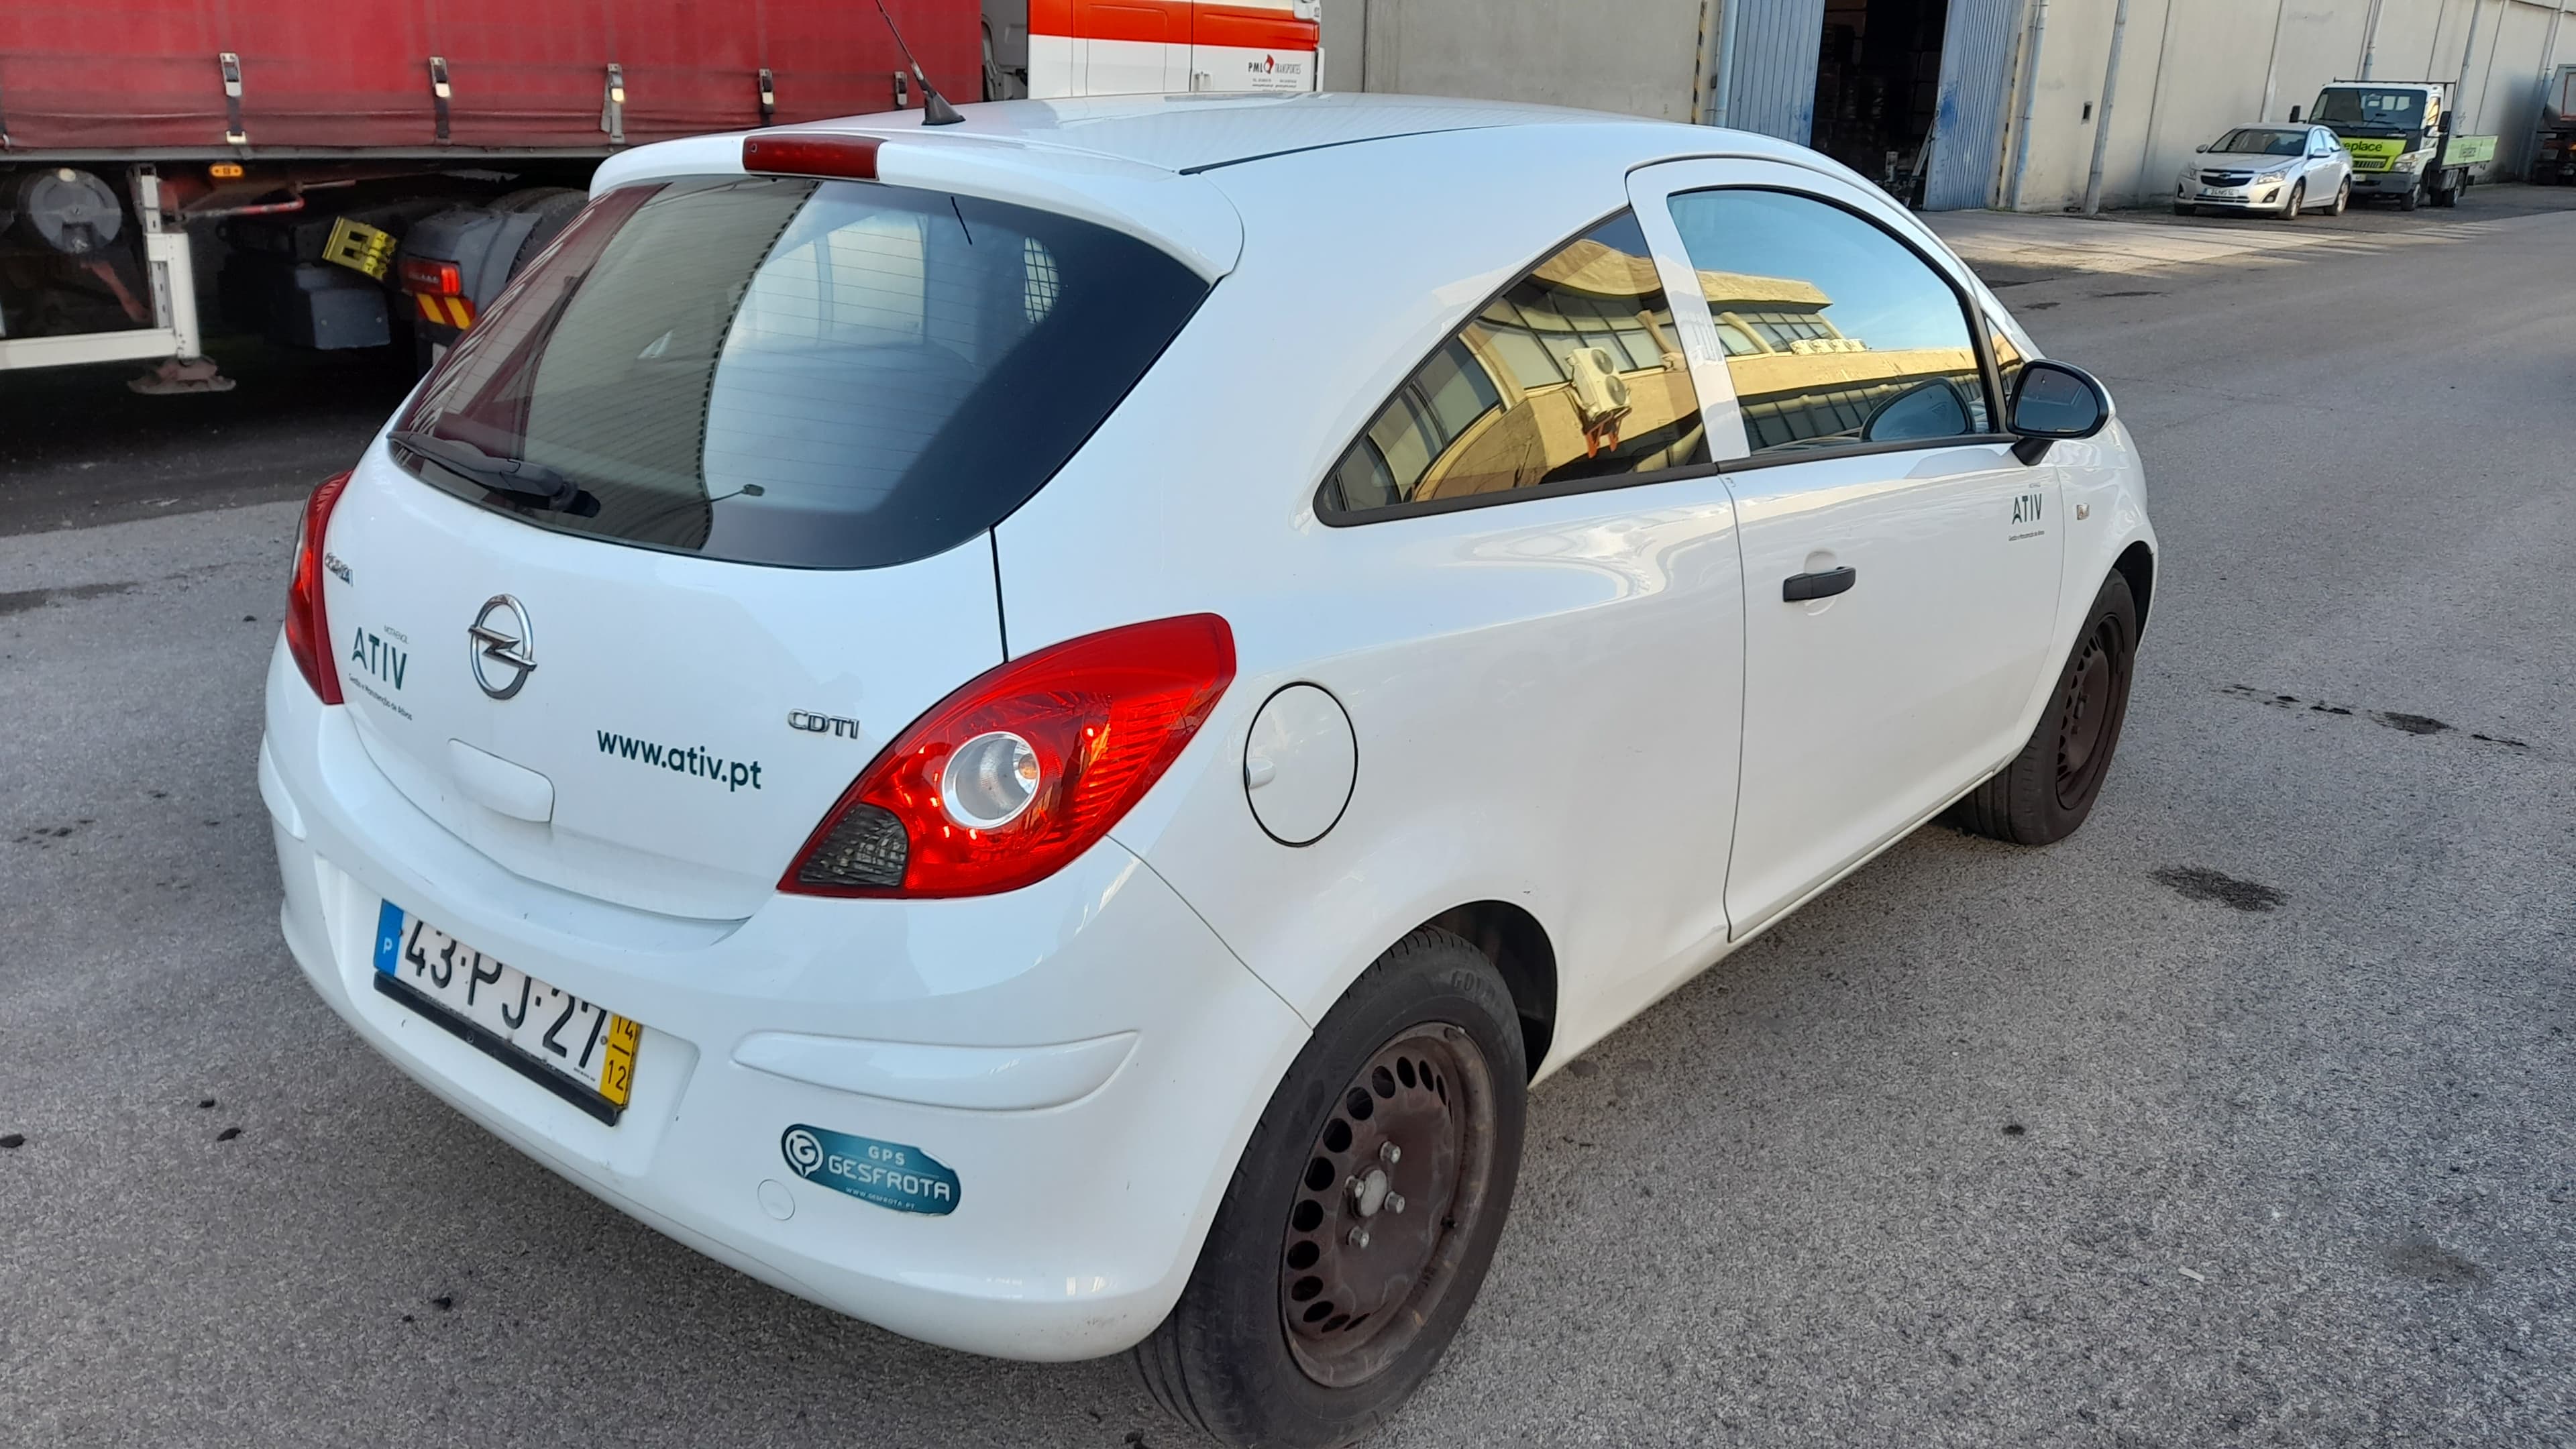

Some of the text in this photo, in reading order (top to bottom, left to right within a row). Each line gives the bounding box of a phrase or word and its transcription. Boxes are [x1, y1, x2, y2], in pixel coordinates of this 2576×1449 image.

[2343, 141, 2383, 152] eplace
[2012, 493, 2042, 525] ATIV
[352, 627, 407, 691] ATIV
[788, 708, 860, 739] CDTI
[596, 729, 762, 792] www.ativ.pt
[383, 937, 392, 954] P
[617, 1016, 633, 1040] 14
[608, 1059, 627, 1091] 12
[867, 1145, 906, 1166] GPS
[828, 1155, 951, 1201] GESFROTA
